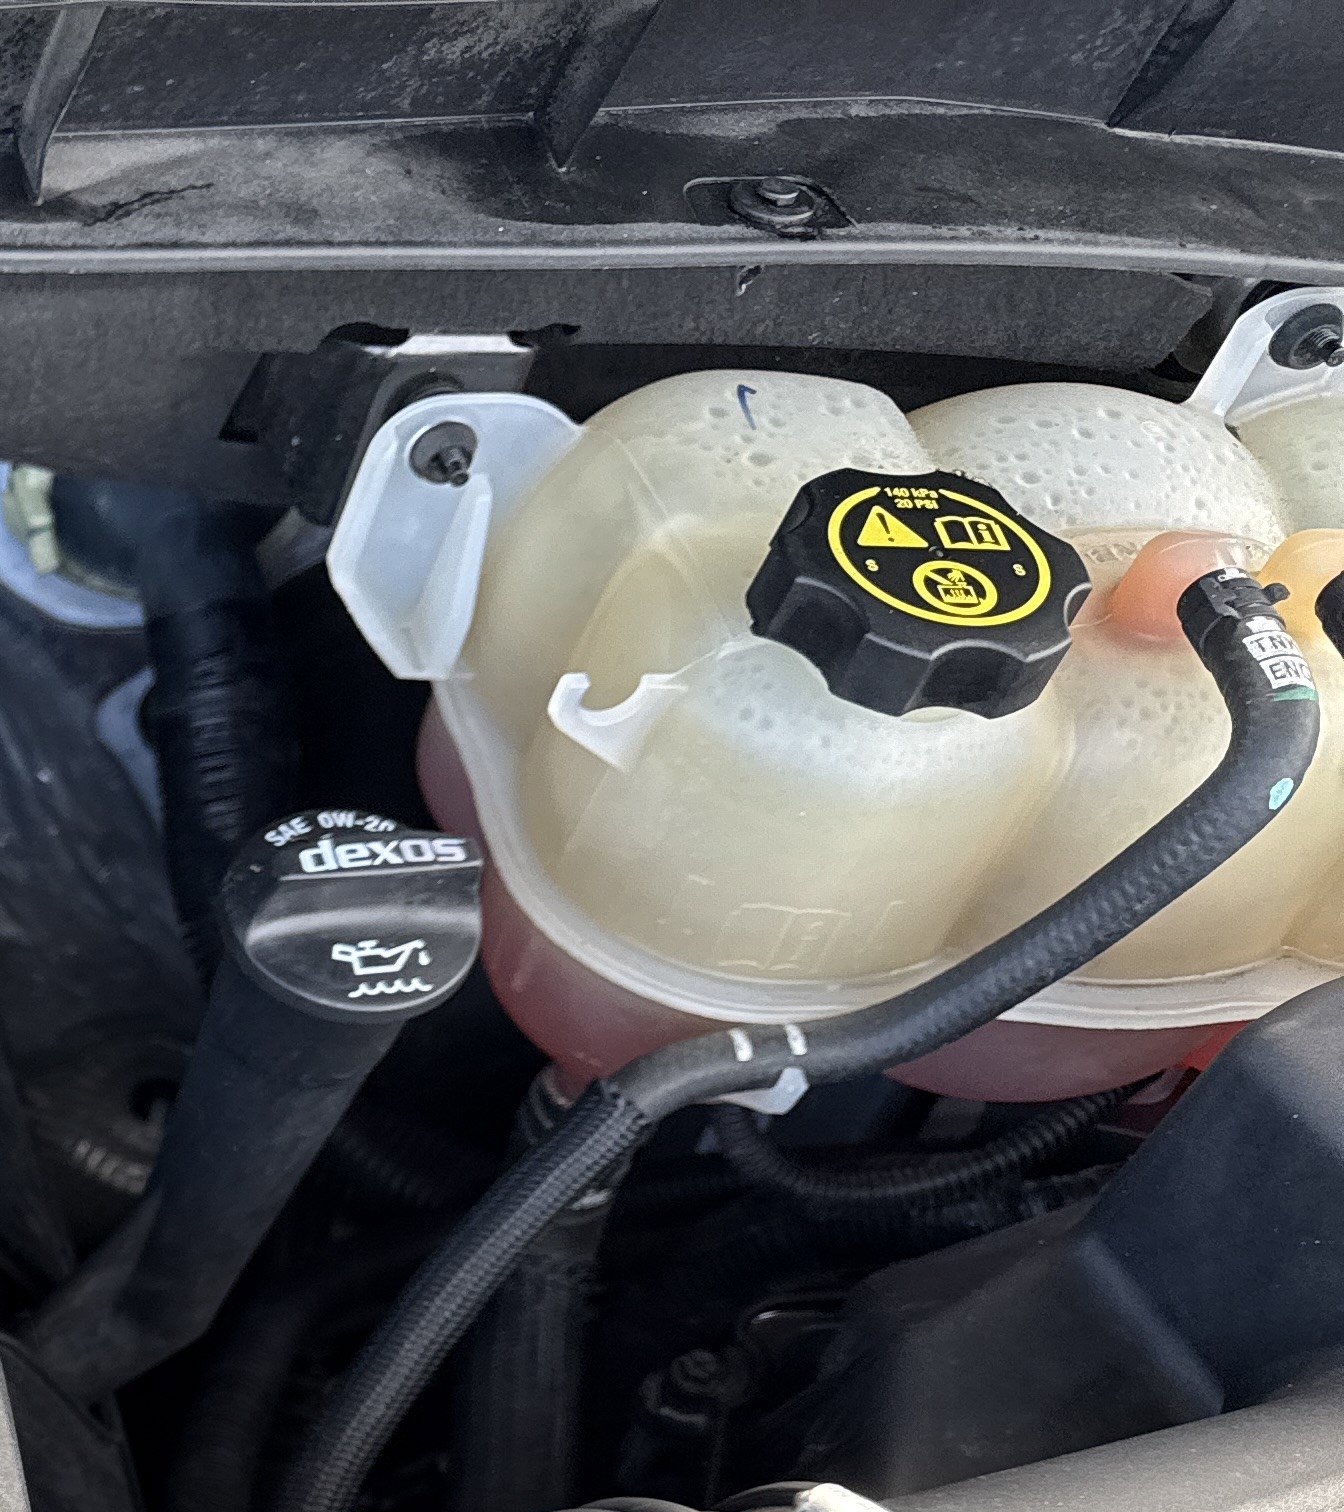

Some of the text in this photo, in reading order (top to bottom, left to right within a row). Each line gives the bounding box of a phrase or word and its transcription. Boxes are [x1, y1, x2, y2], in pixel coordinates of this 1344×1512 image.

[883, 486, 939, 498] 140 kPa
[894, 498, 939, 509] 20 PSI
[265, 815, 312, 847] SAE
[298, 836, 466, 873] dexos
